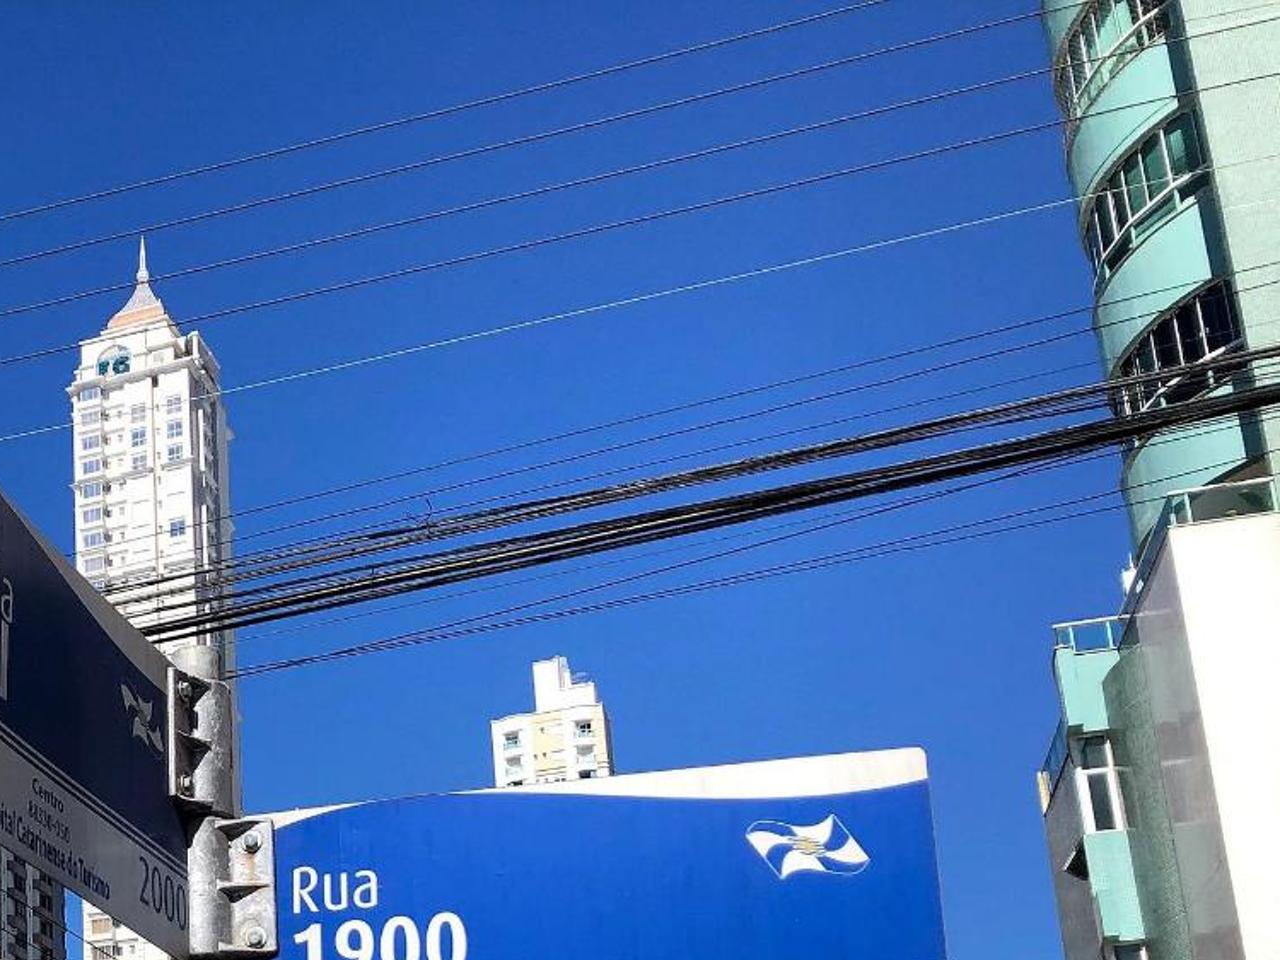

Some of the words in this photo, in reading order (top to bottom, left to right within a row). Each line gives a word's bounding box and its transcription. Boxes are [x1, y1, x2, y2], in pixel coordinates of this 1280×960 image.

[32, 778, 64, 813] Centro
[16, 815, 67, 872] Catarinense
[67, 851, 79, 880] do
[78, 857, 111, 901] Turismo
[139, 855, 187, 931] 2000
[292, 866, 380, 914] Rua
